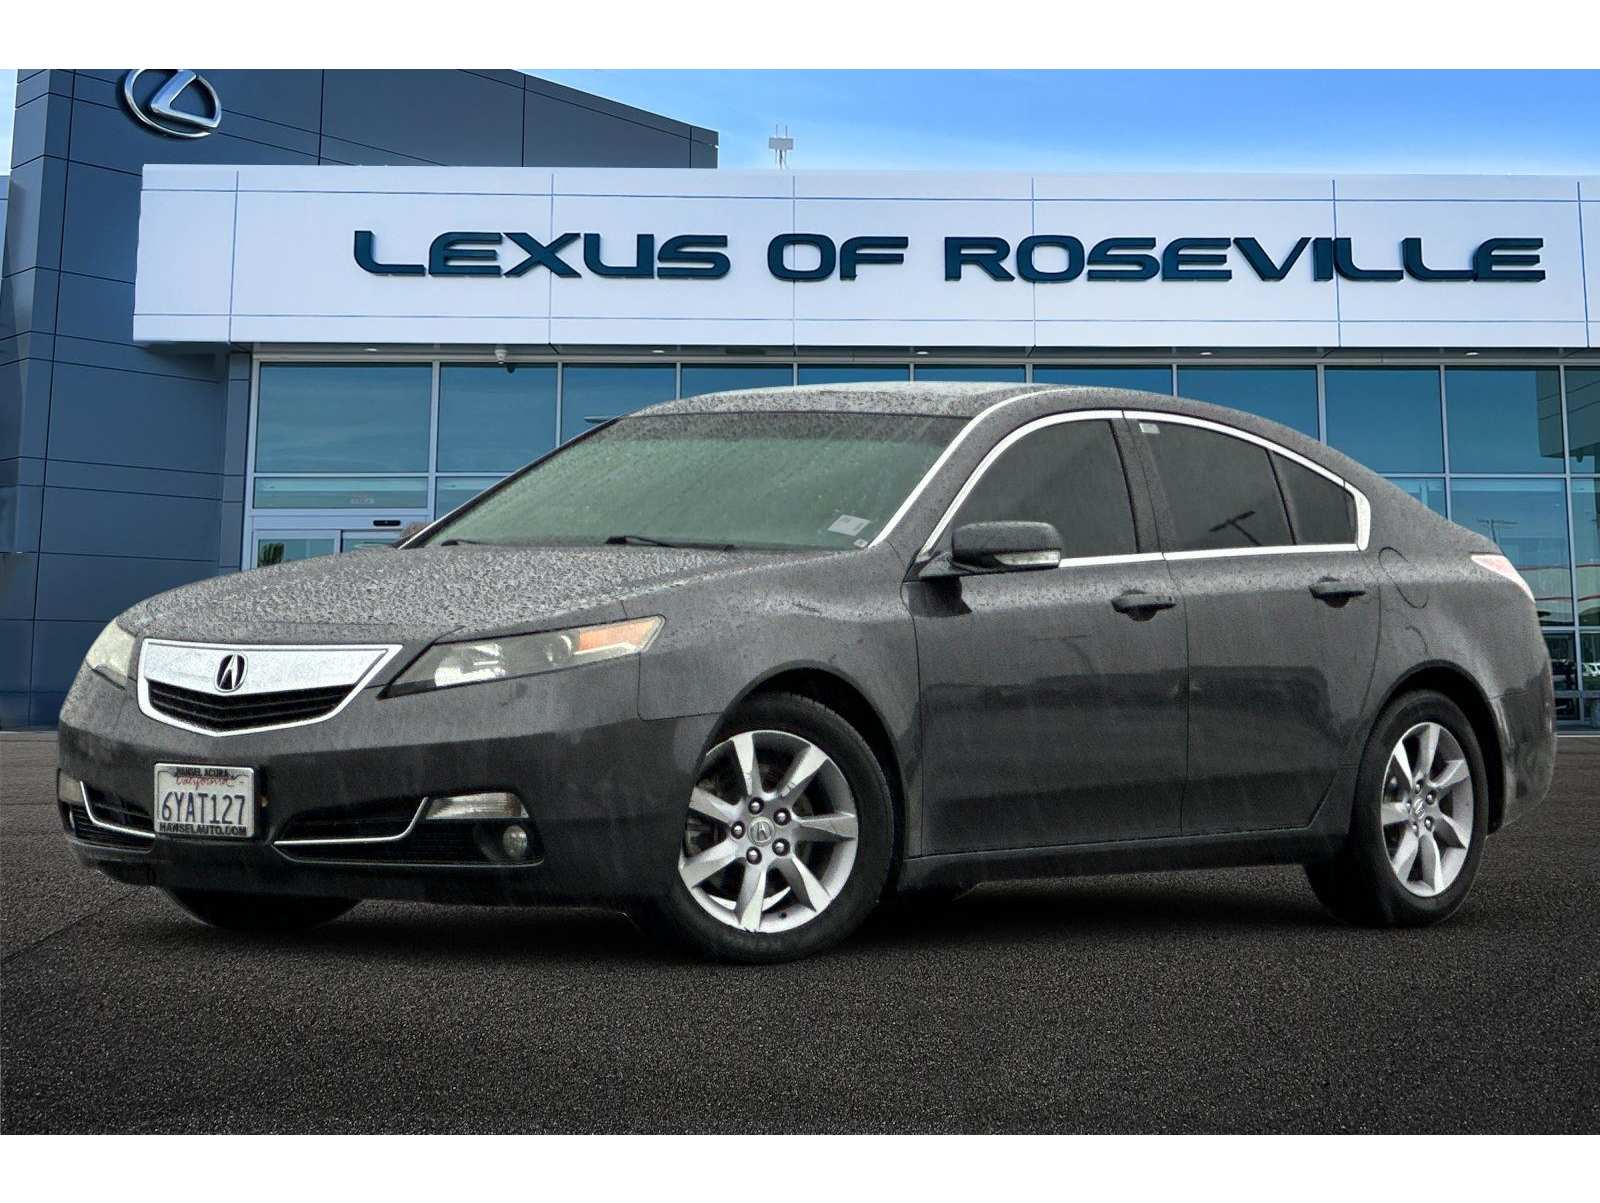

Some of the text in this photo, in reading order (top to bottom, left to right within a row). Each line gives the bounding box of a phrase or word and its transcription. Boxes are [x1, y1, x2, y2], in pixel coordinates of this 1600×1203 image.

[354, 230, 1546, 282] LEXUS OF ROSEVILLE
[162, 791, 246, 824] 6YAT127
